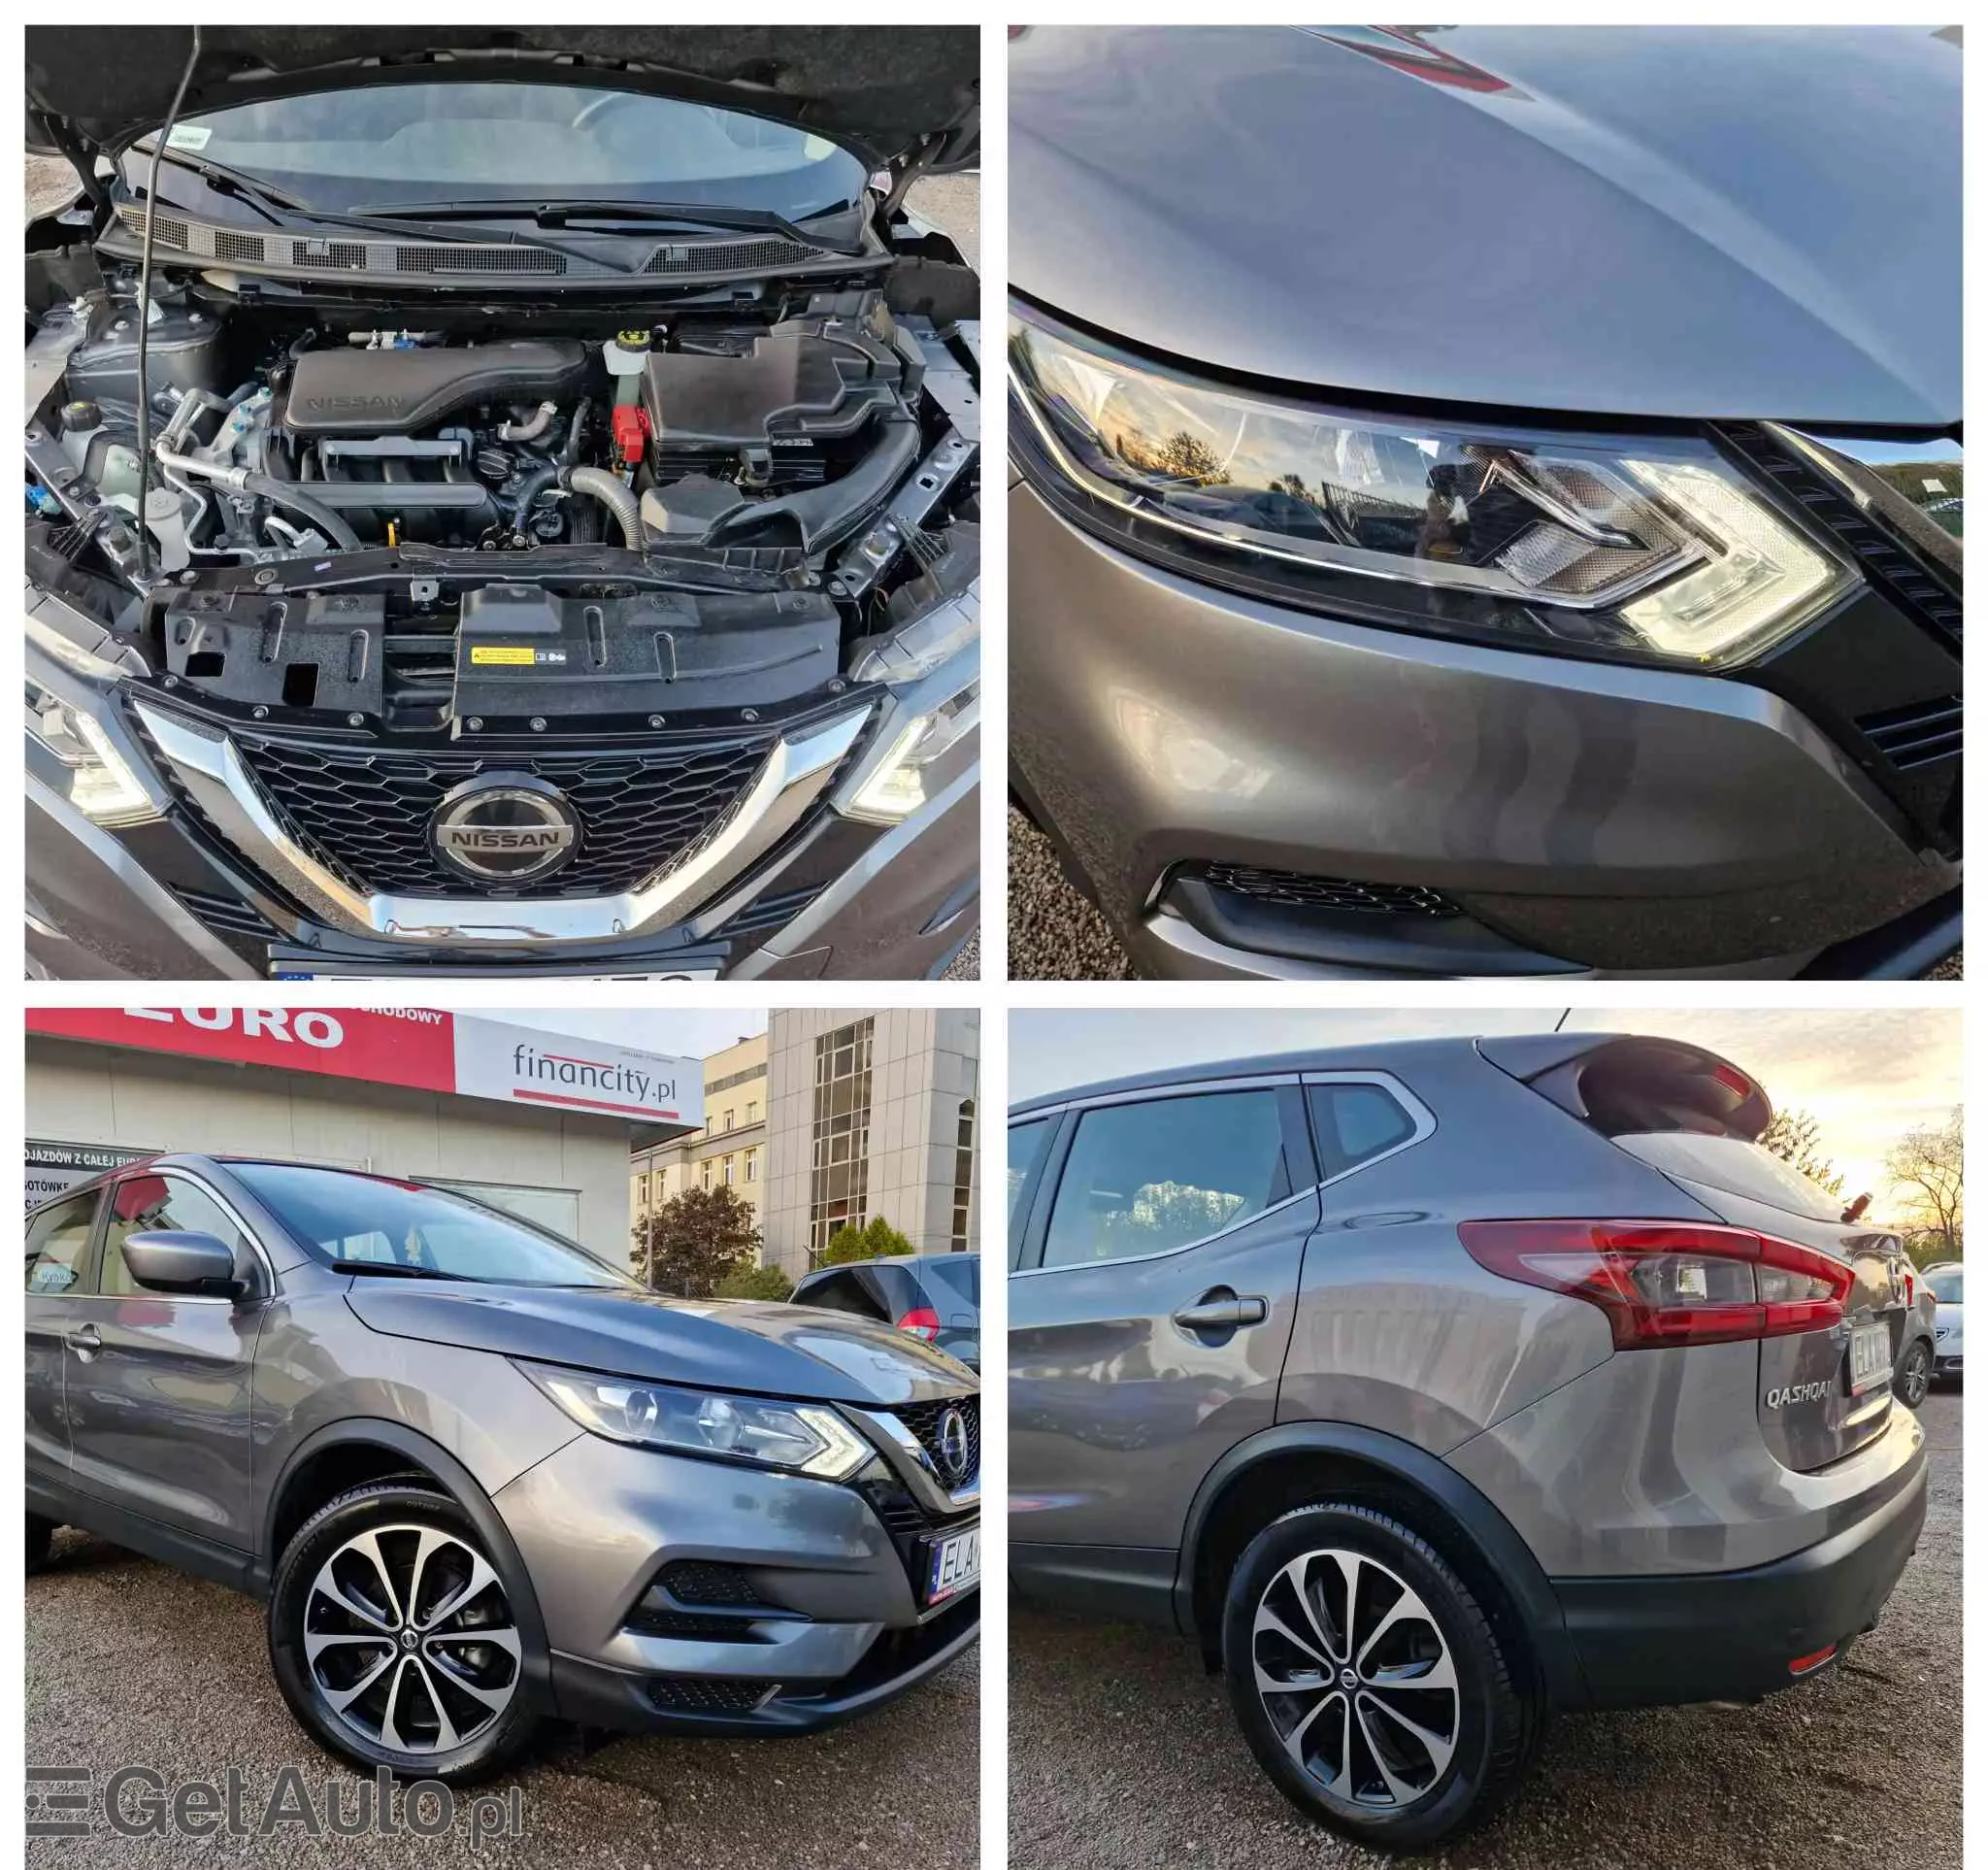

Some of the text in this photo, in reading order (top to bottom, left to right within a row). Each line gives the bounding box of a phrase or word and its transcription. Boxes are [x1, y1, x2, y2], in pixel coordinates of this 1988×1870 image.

[307, 394, 405, 413] NISSAN
[451, 832, 559, 848] NISSAN
[514, 1044, 677, 1103] financity.pl
[74, 1152, 82, 1164] Z
[1767, 1381, 1832, 1409] QASHQAI
